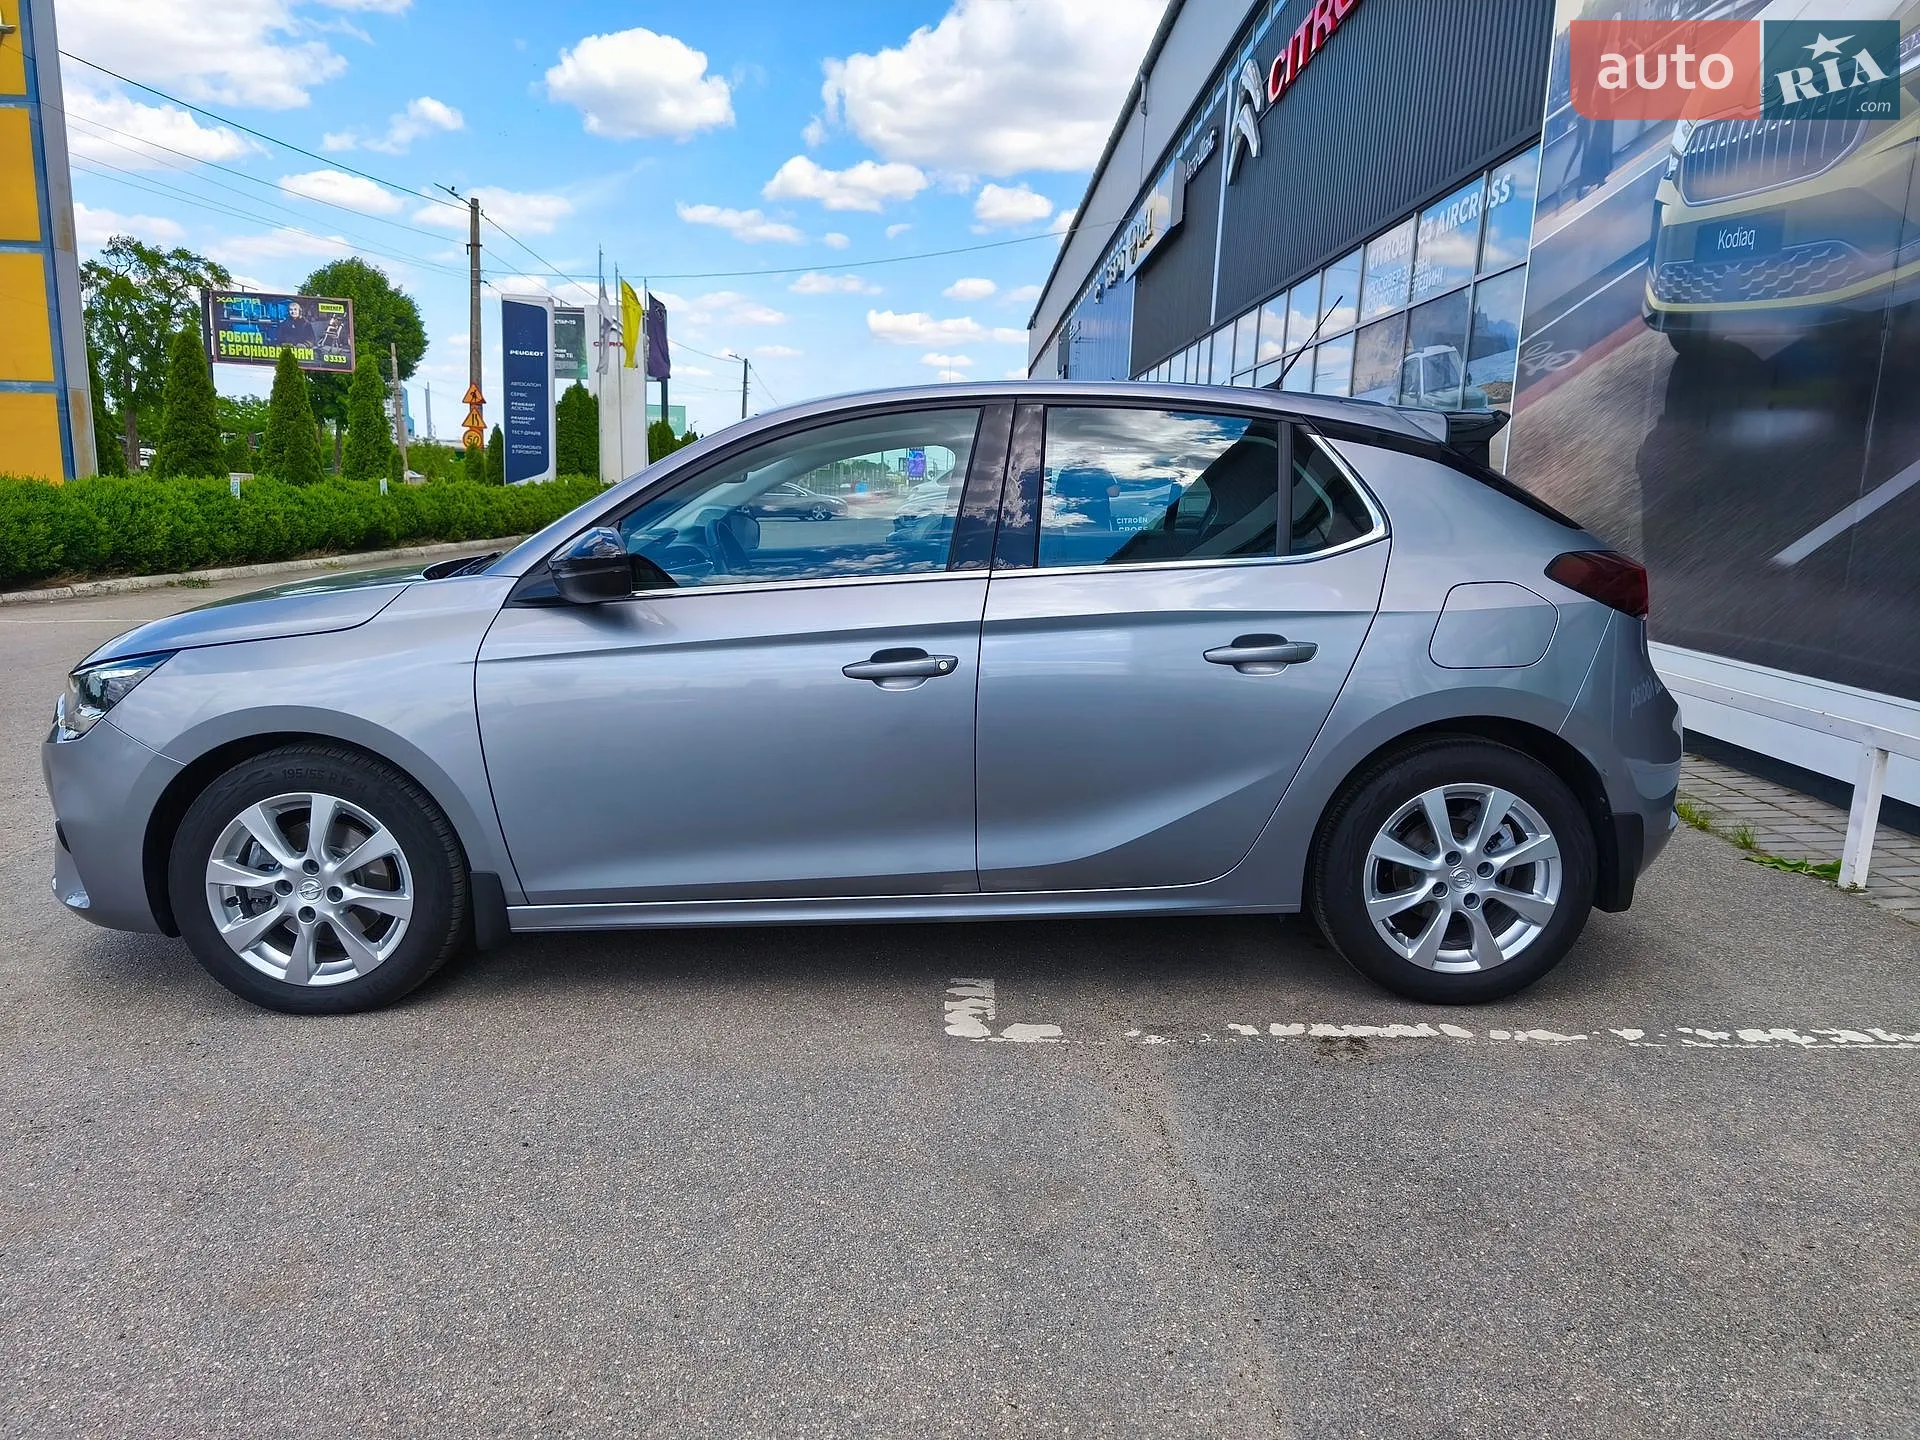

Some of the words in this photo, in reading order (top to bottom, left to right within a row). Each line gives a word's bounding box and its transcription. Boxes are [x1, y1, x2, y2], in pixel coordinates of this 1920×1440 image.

[1436, 174, 1511, 240] AIRCROSS
[1717, 226, 1756, 250] Kodiaq
[219, 330, 263, 344] РОБОТА
[220, 343, 227, 355] З
[228, 344, 315, 360] БРОНЮВАНЯМ
[509, 349, 545, 357] PEUGEOT
[467, 435, 480, 447] 50
[282, 768, 325, 779] 195/55
[328, 772, 338, 783] R
